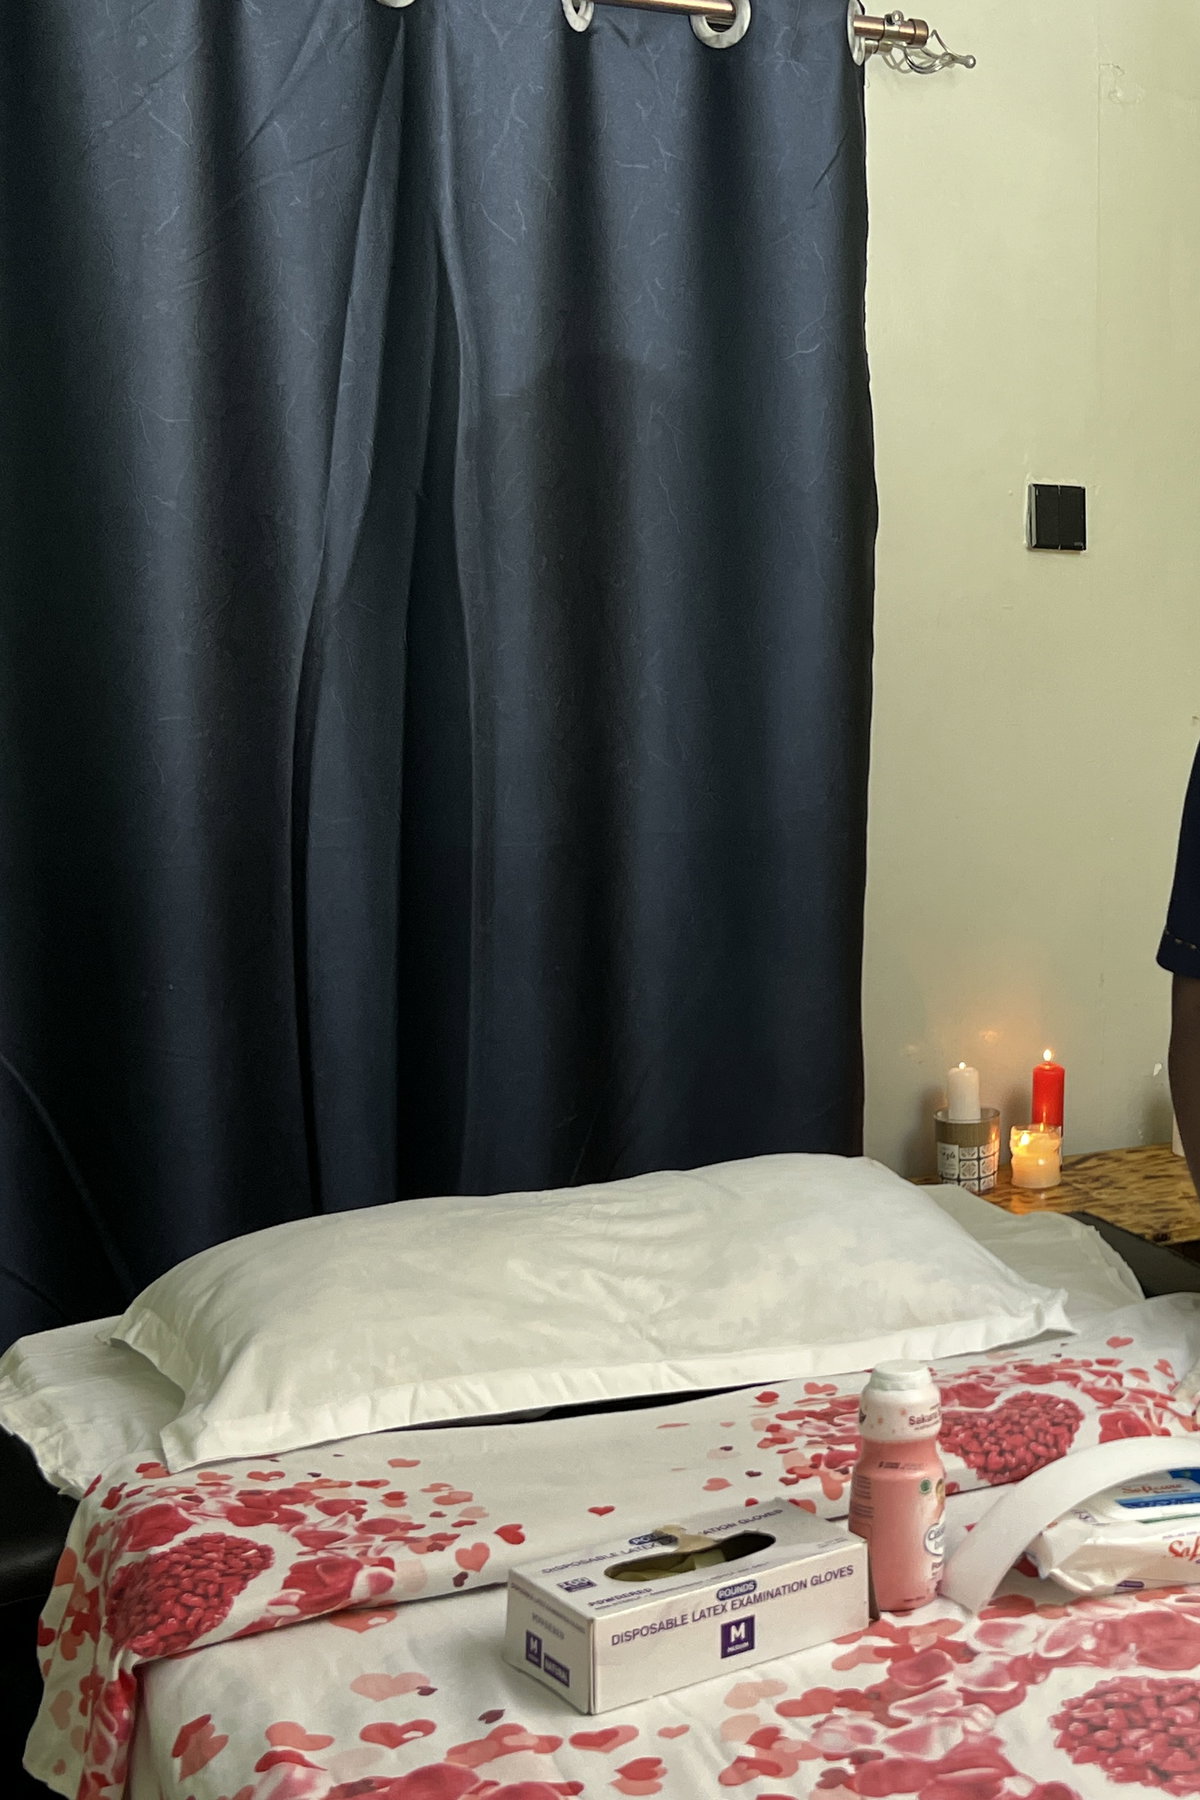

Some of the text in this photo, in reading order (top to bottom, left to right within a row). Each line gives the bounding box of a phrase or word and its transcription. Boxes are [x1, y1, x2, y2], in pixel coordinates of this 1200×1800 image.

[541, 1551, 620, 1575] DISPOSABLE
[718, 1581, 755, 1599] POUNDS
[611, 1564, 854, 1646] DISPOSABLE LATEX EXAMINATION GLOVES
[730, 1622, 746, 1643] M
